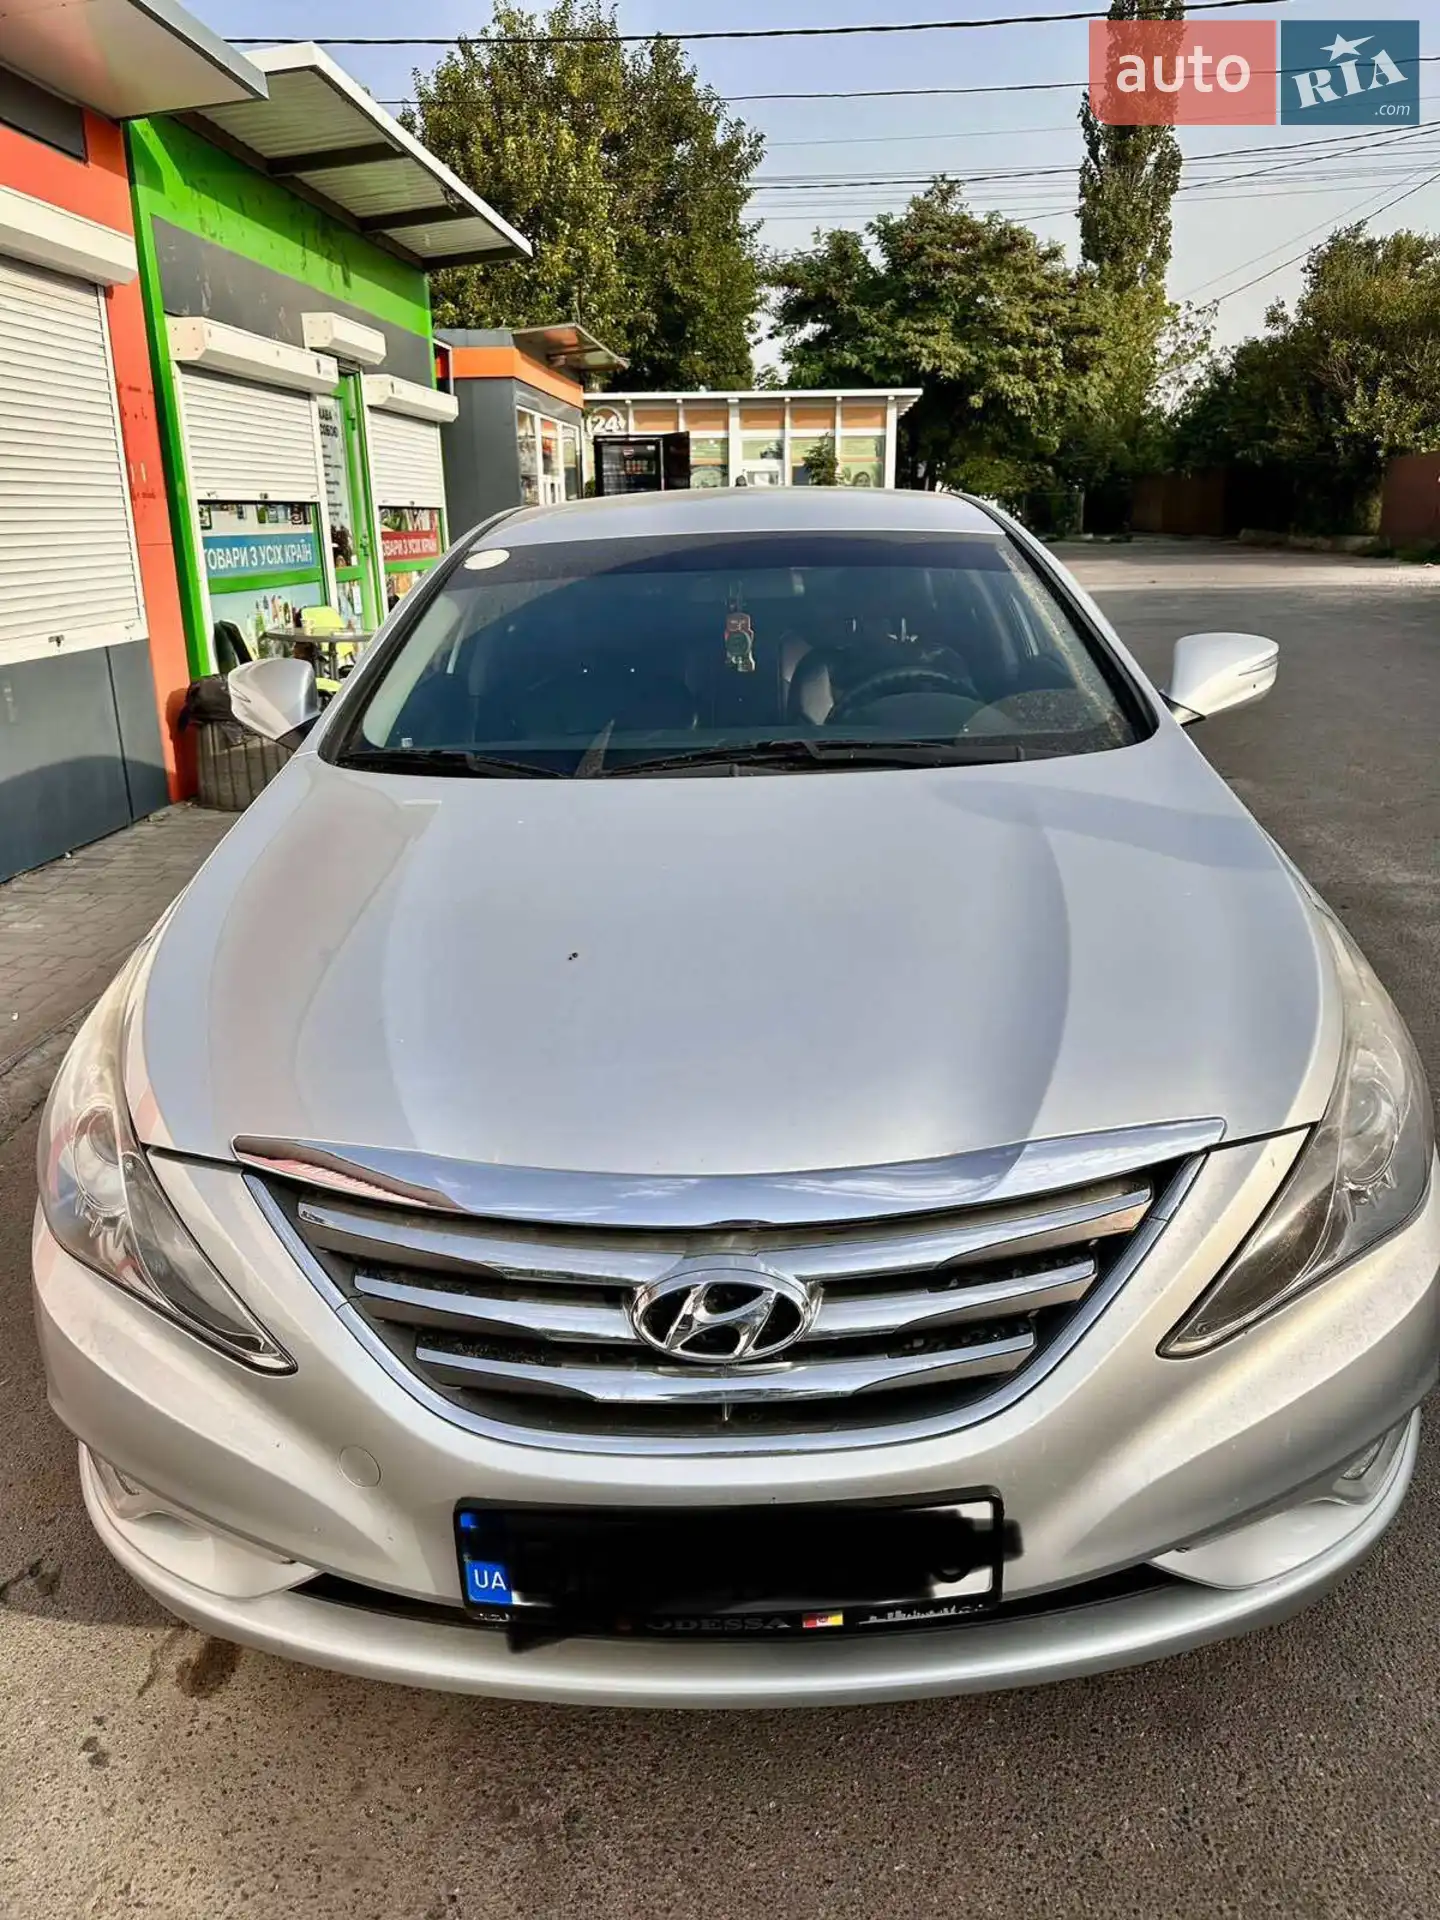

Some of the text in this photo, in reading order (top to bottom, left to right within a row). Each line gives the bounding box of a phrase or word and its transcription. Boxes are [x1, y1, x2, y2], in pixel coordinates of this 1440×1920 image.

[592, 414, 620, 433] 24
[204, 546, 249, 570] ОВАРИ
[284, 538, 313, 563] КРАЇН
[474, 1569, 507, 1591] UA
